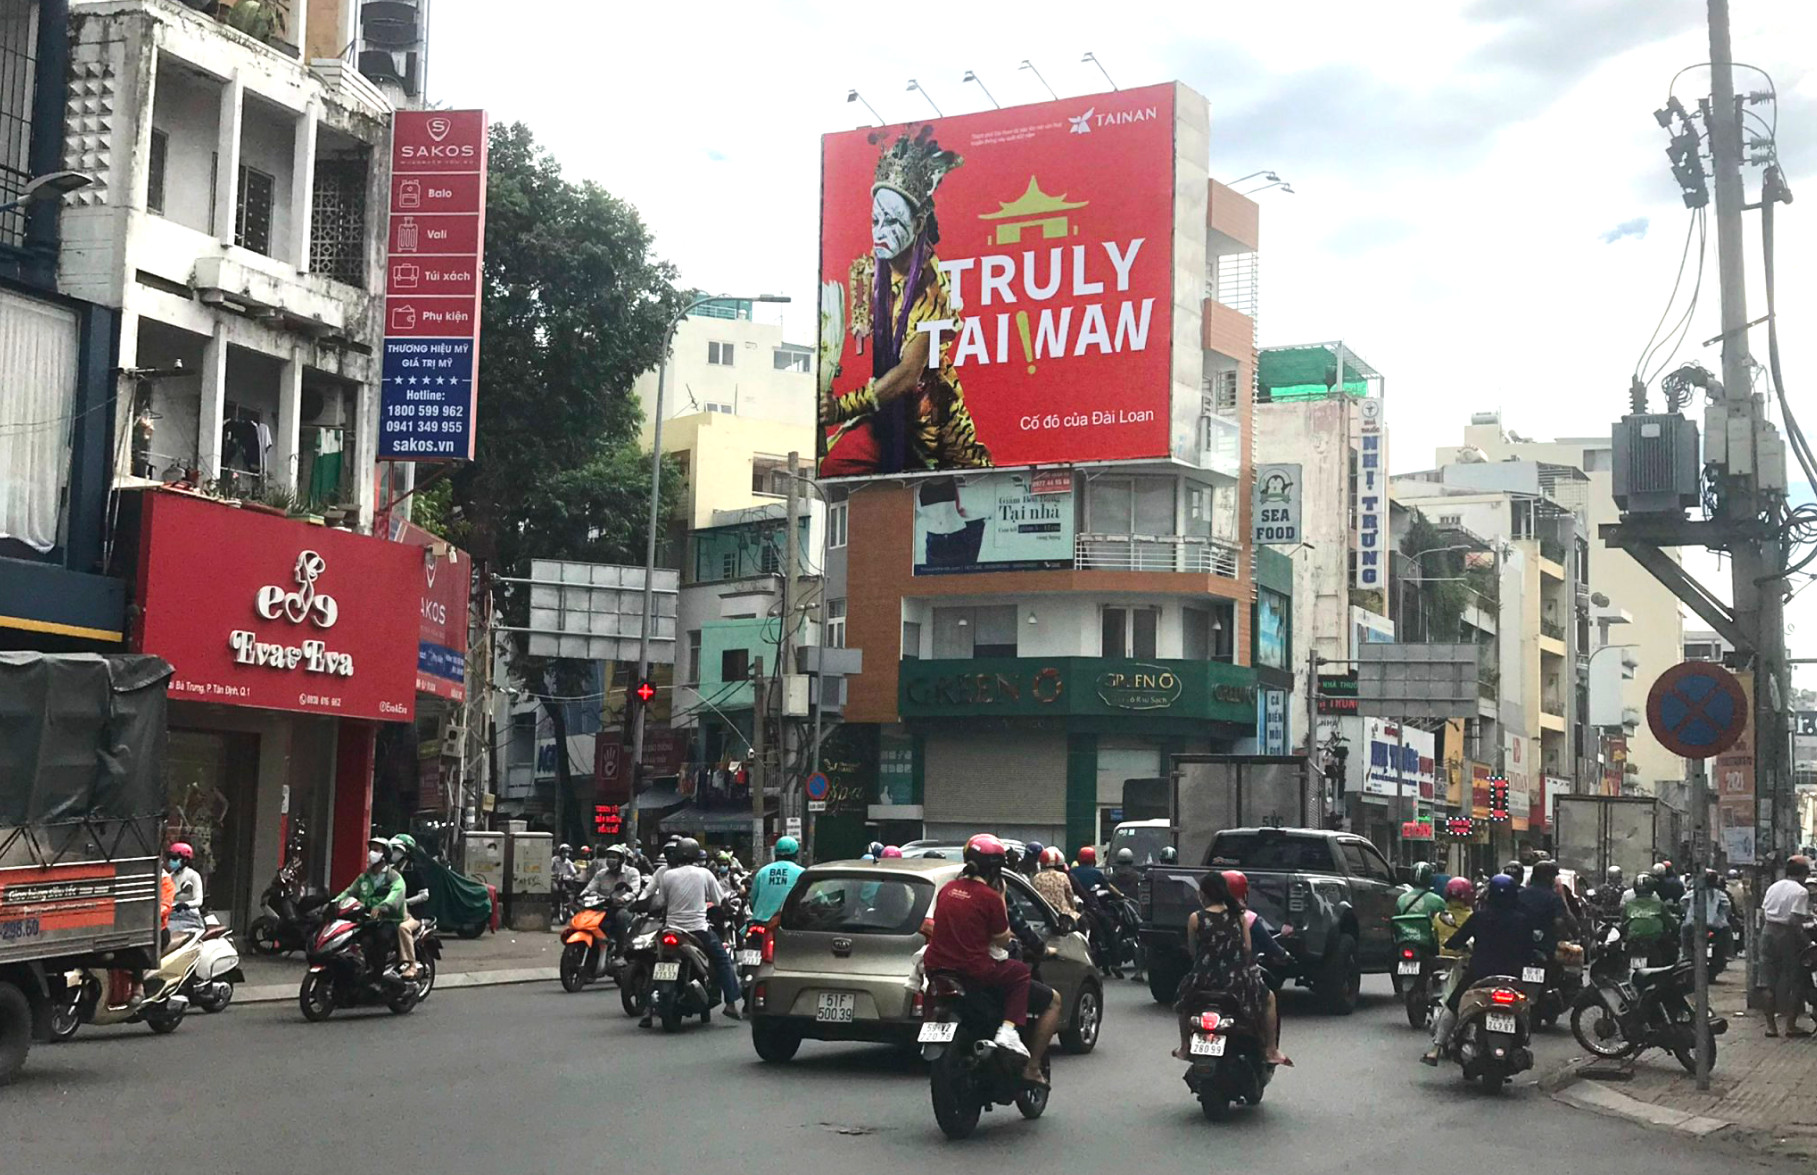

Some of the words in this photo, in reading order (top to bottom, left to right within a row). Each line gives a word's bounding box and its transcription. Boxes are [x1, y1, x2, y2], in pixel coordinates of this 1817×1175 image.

[1095, 106, 1157, 127] TAINAN
[401, 145, 475, 157] SAKOS
[428, 188, 453, 199] Balo
[427, 229, 448, 240] Vali
[424, 271, 440, 281] Túi
[443, 271, 471, 281] xách
[938, 237, 1146, 310] TRULY
[422, 311, 442, 324] Phụ
[445, 311, 469, 324] kiện
[388, 344, 428, 354] THƯƠNG
[430, 343, 452, 355] HIỆU
[454, 343, 469, 354] MỸ
[401, 357, 420, 368] GIÁ
[422, 359, 436, 370] TRỊ
[438, 357, 453, 368] MỸ
[406, 389, 446, 401] Hotline:
[387, 404, 415, 417] 1800
[418, 405, 440, 417] 599
[442, 405, 464, 417] 962
[386, 420, 414, 433] 0941
[417, 421, 438, 433] 349
[441, 421, 463, 433] 955
[1020, 413, 1040, 431] Cố
[1043, 411, 1060, 430] đô
[1063, 411, 1089, 428] của
[1092, 409, 1115, 426] Đài
[1118, 409, 1154, 424] Loan
[393, 437, 455, 452] sakos.vn
[998, 505, 1026, 523] Tại
[1261, 508, 1290, 522] SEA
[1256, 526, 1296, 540] FOOD
[769, 868, 788, 876] BAE
[768, 876, 788, 886] MIN
[826, 994, 847, 1007] 51F
[817, 1006, 853, 1021] 500.39
